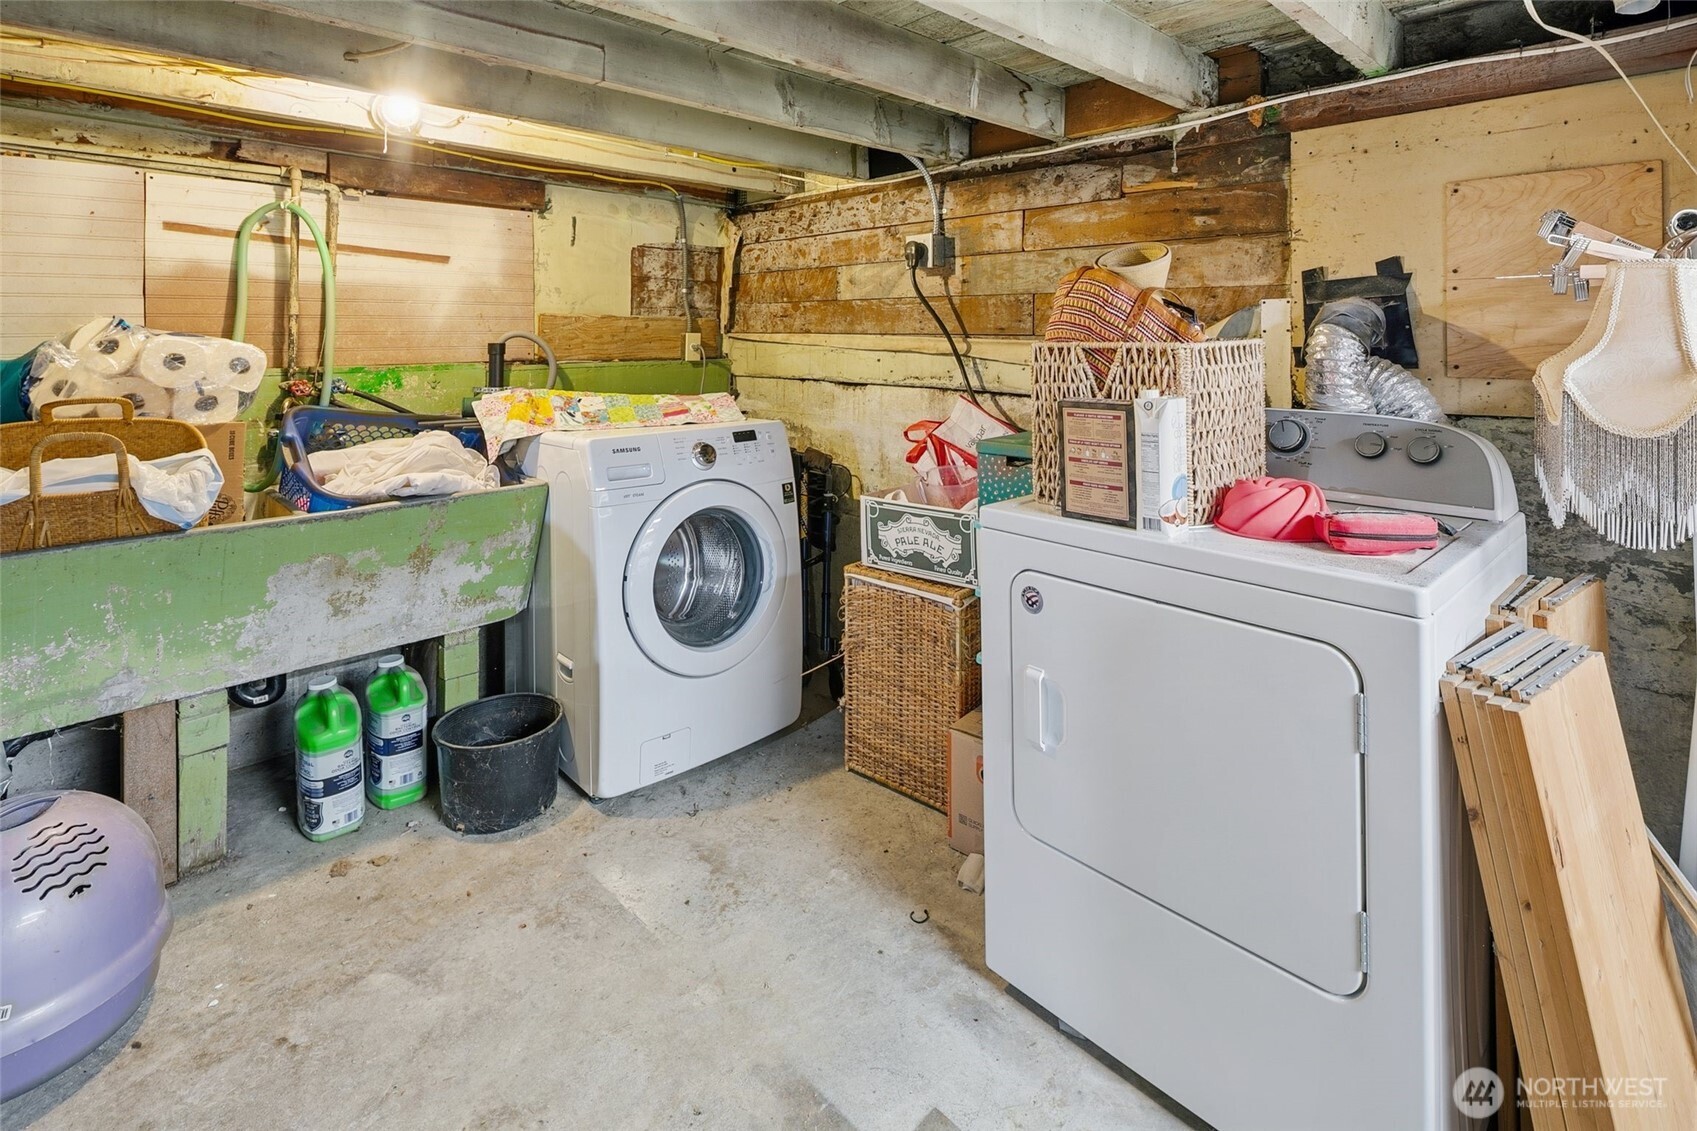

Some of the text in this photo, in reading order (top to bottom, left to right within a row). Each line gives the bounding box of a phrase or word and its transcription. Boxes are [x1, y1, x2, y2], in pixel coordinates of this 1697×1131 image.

[612, 446, 641, 454] SAMSUNG
[897, 525, 941, 542] SIERRA NEVADA
[894, 536, 945, 555] PALE ALE
